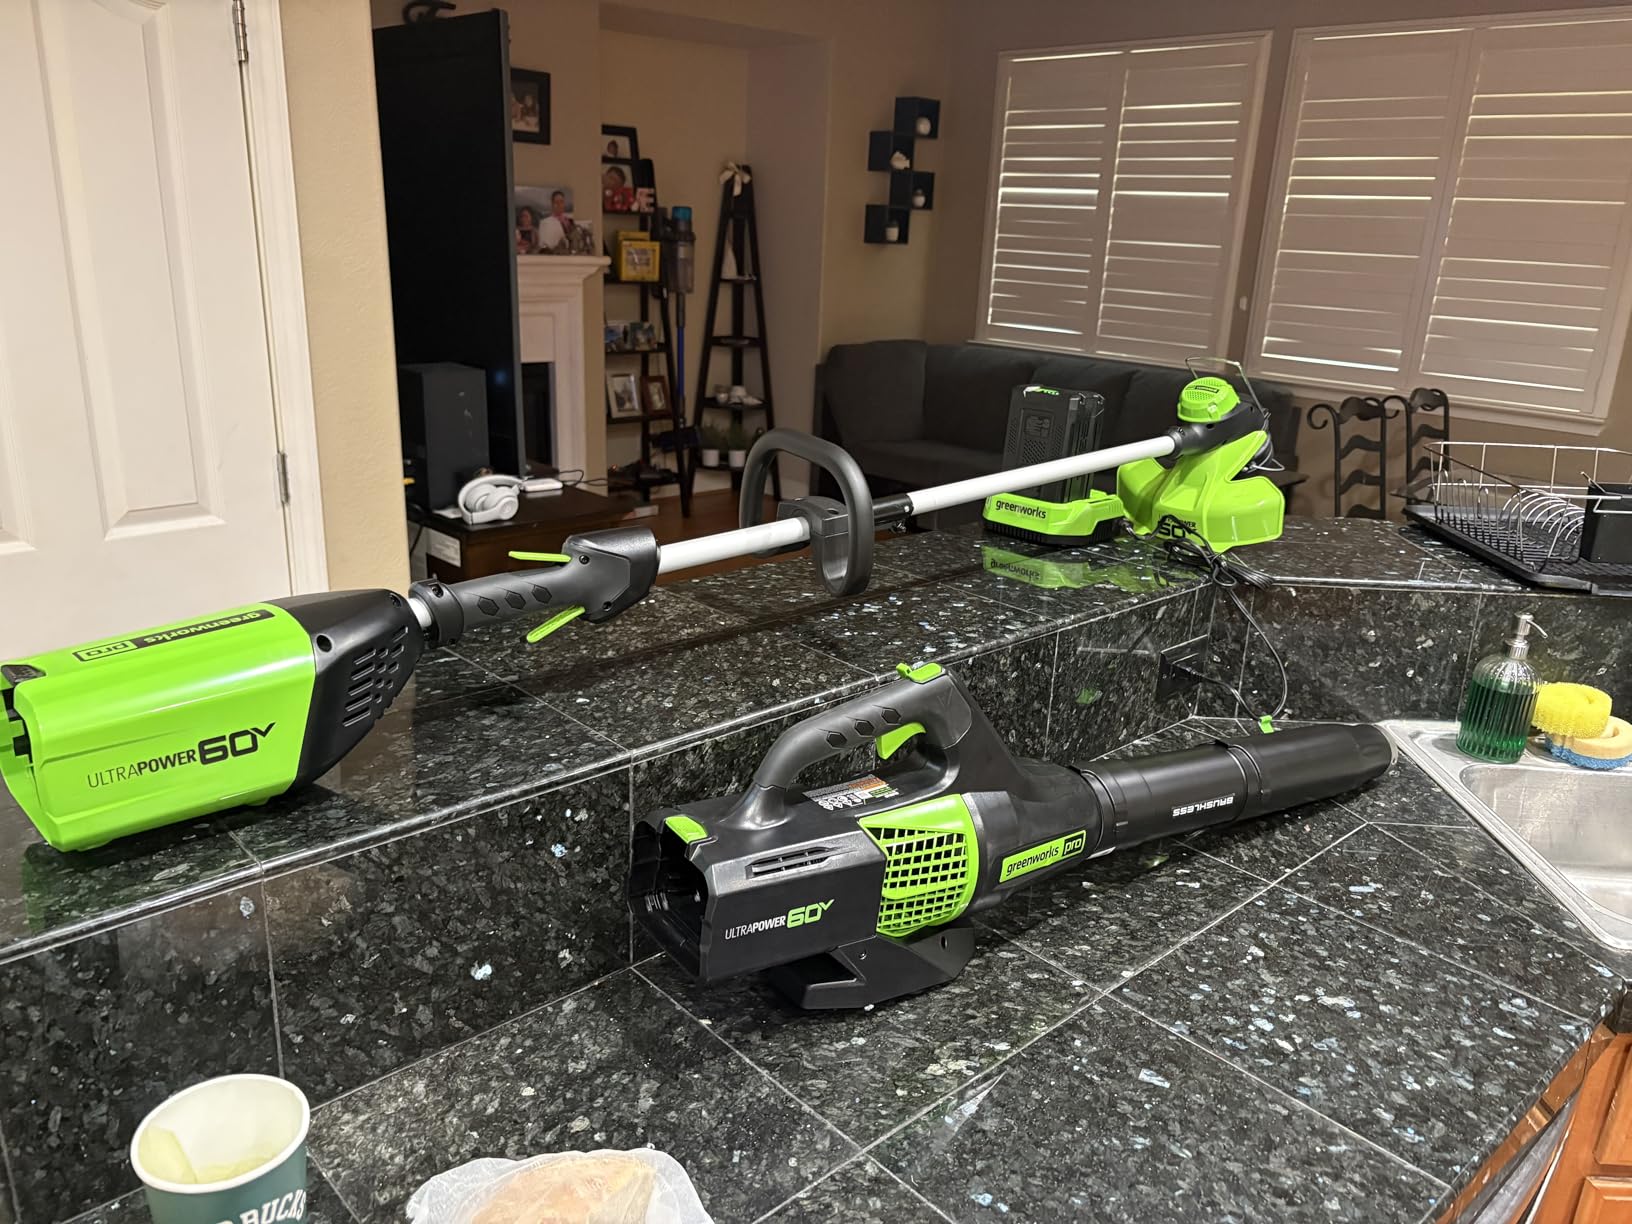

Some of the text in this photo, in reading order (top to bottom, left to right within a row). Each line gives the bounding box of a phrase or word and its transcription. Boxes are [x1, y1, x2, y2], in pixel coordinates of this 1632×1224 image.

[995, 500, 1047, 519] greenworks
[85, 611, 262, 656] greenworks pro
[87, 722, 276, 788] ULTRAPOWER 60V
[1172, 796, 1234, 817] BRUSHLESS
[1006, 838, 1082, 876] greenworks pro
[724, 899, 835, 940] ULTRAPOWER 60V
